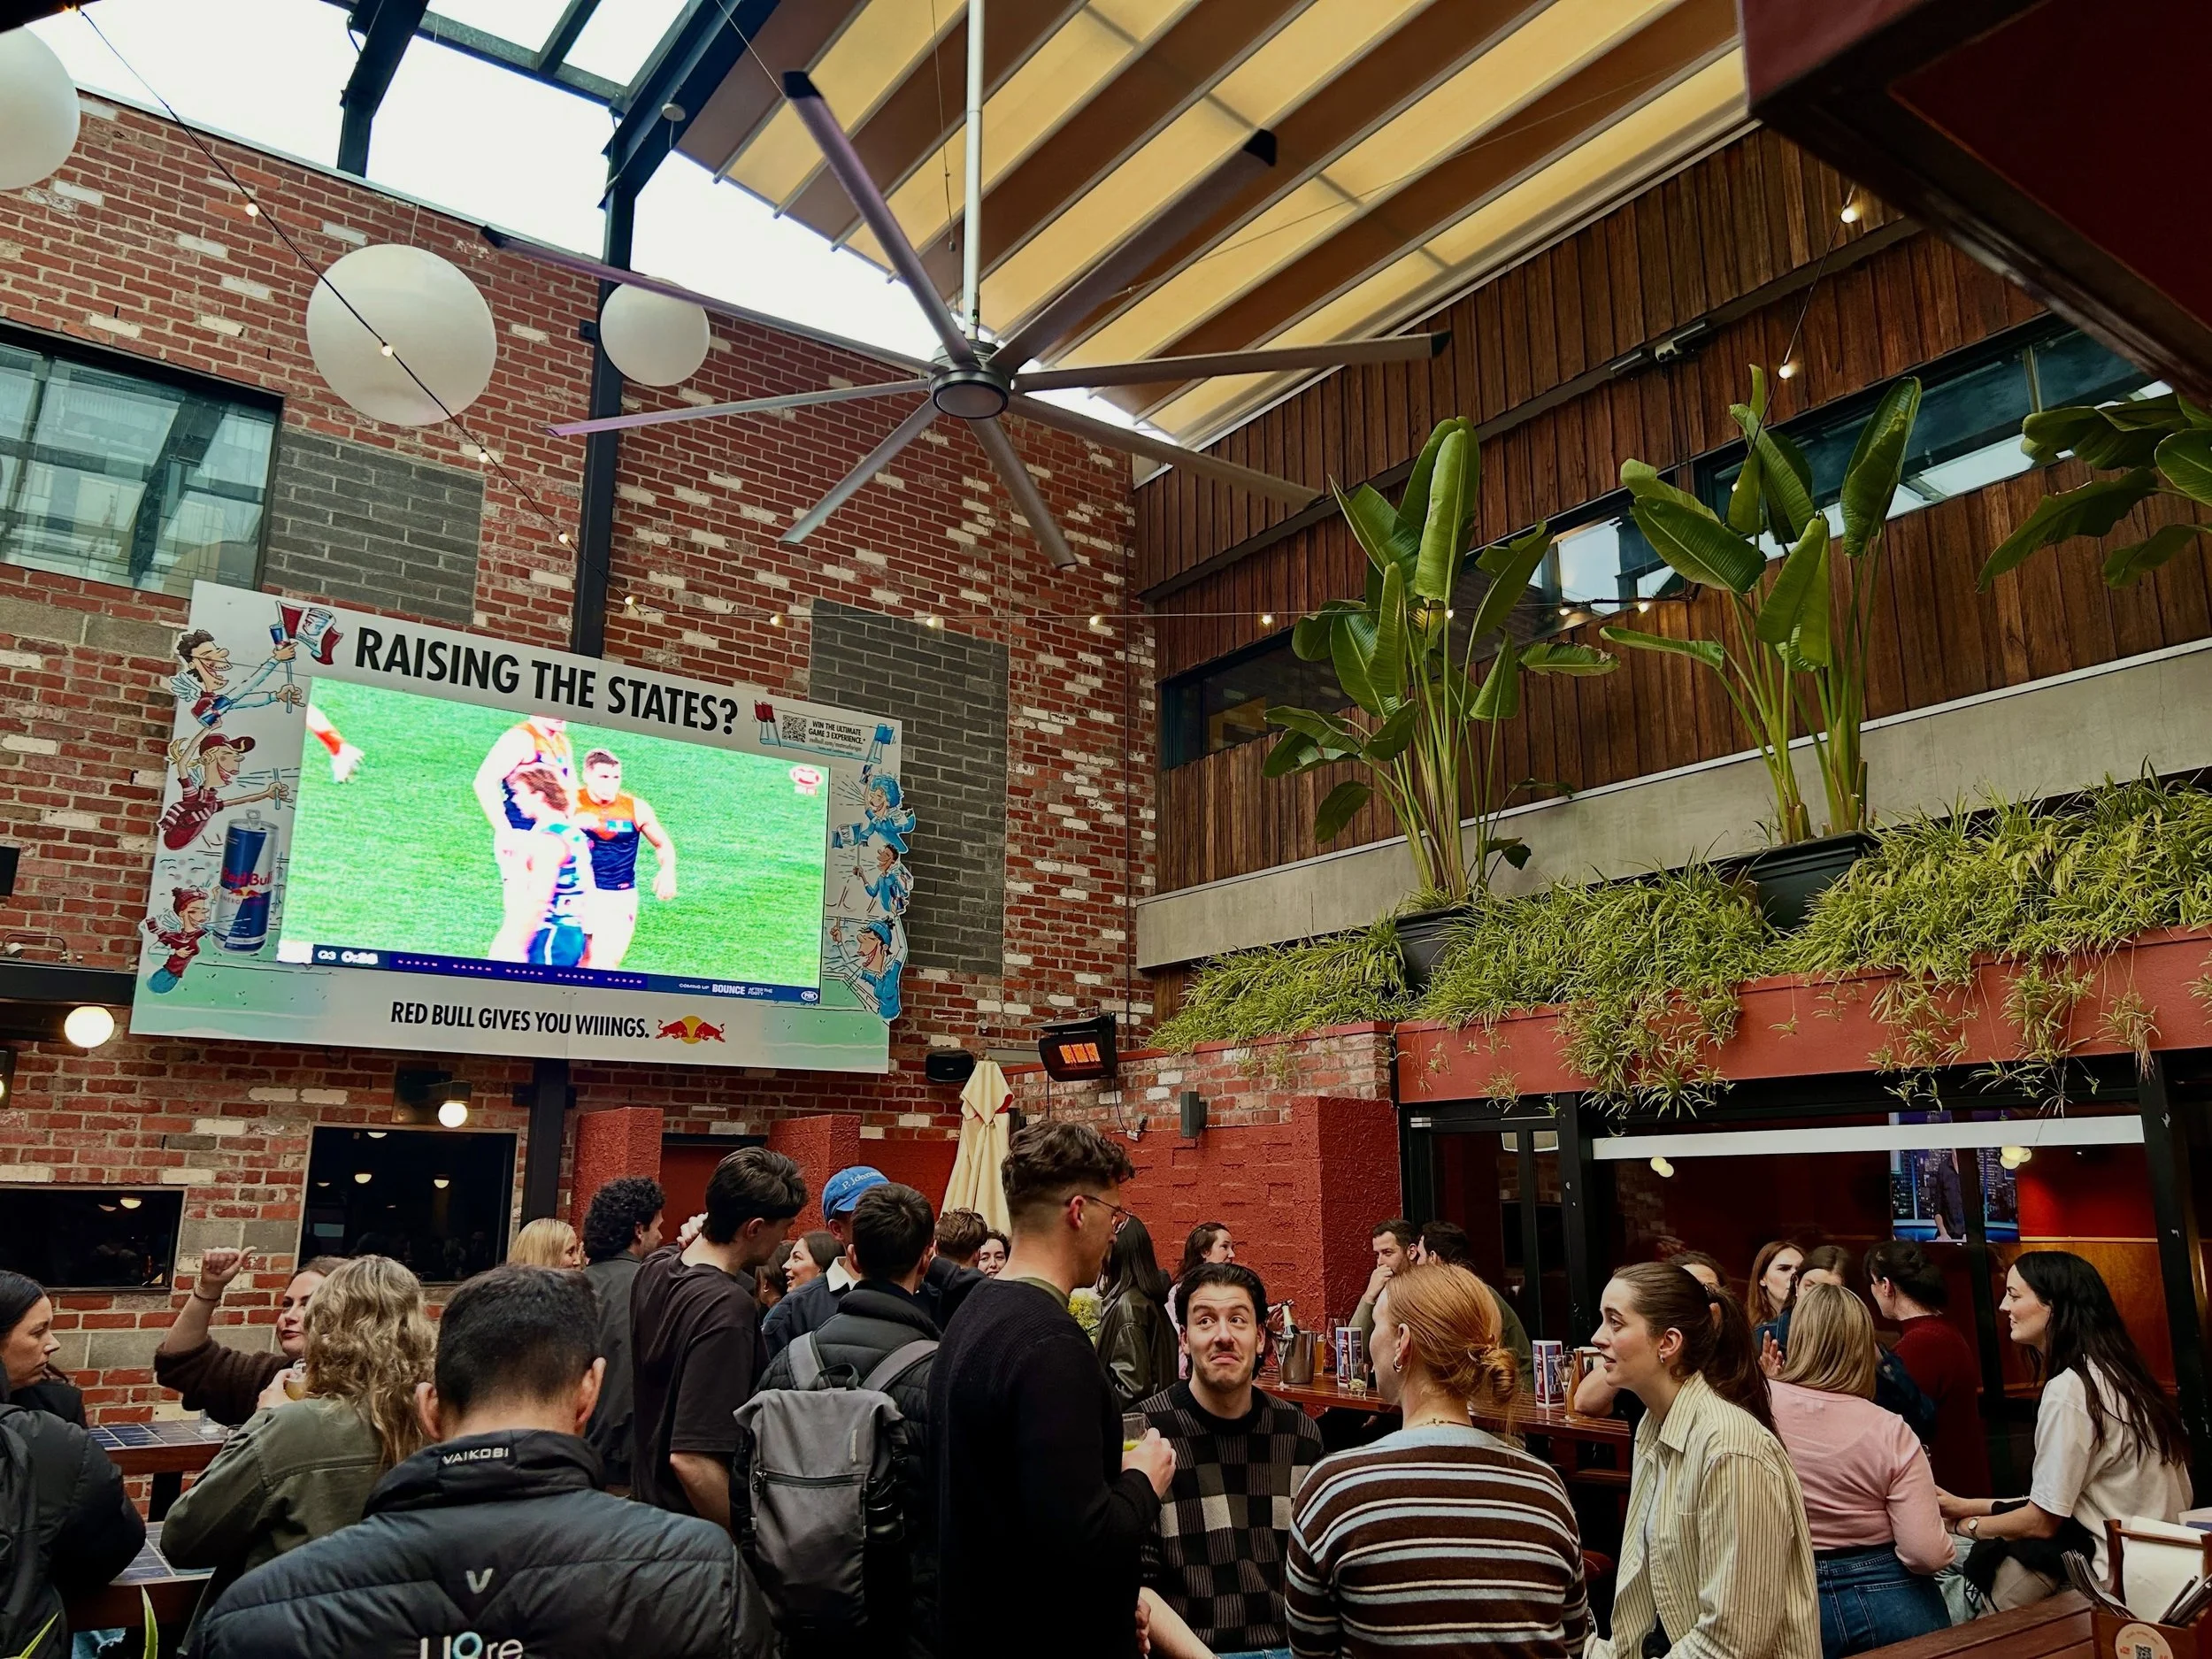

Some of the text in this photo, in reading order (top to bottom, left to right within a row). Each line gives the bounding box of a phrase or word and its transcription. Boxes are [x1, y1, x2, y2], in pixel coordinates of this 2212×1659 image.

[355, 626, 738, 734] RAISING THE STATES?
[808, 728, 825, 738] GAME
[812, 720, 862, 736] WIN THE ULTIMATE
[221, 868, 273, 886] Red Bull
[711, 983, 746, 995] BOUNCE
[390, 1001, 650, 1039] RED BULL GIVES YOU WIIINGS.
[442, 1447, 510, 1465] VAIKOBI
